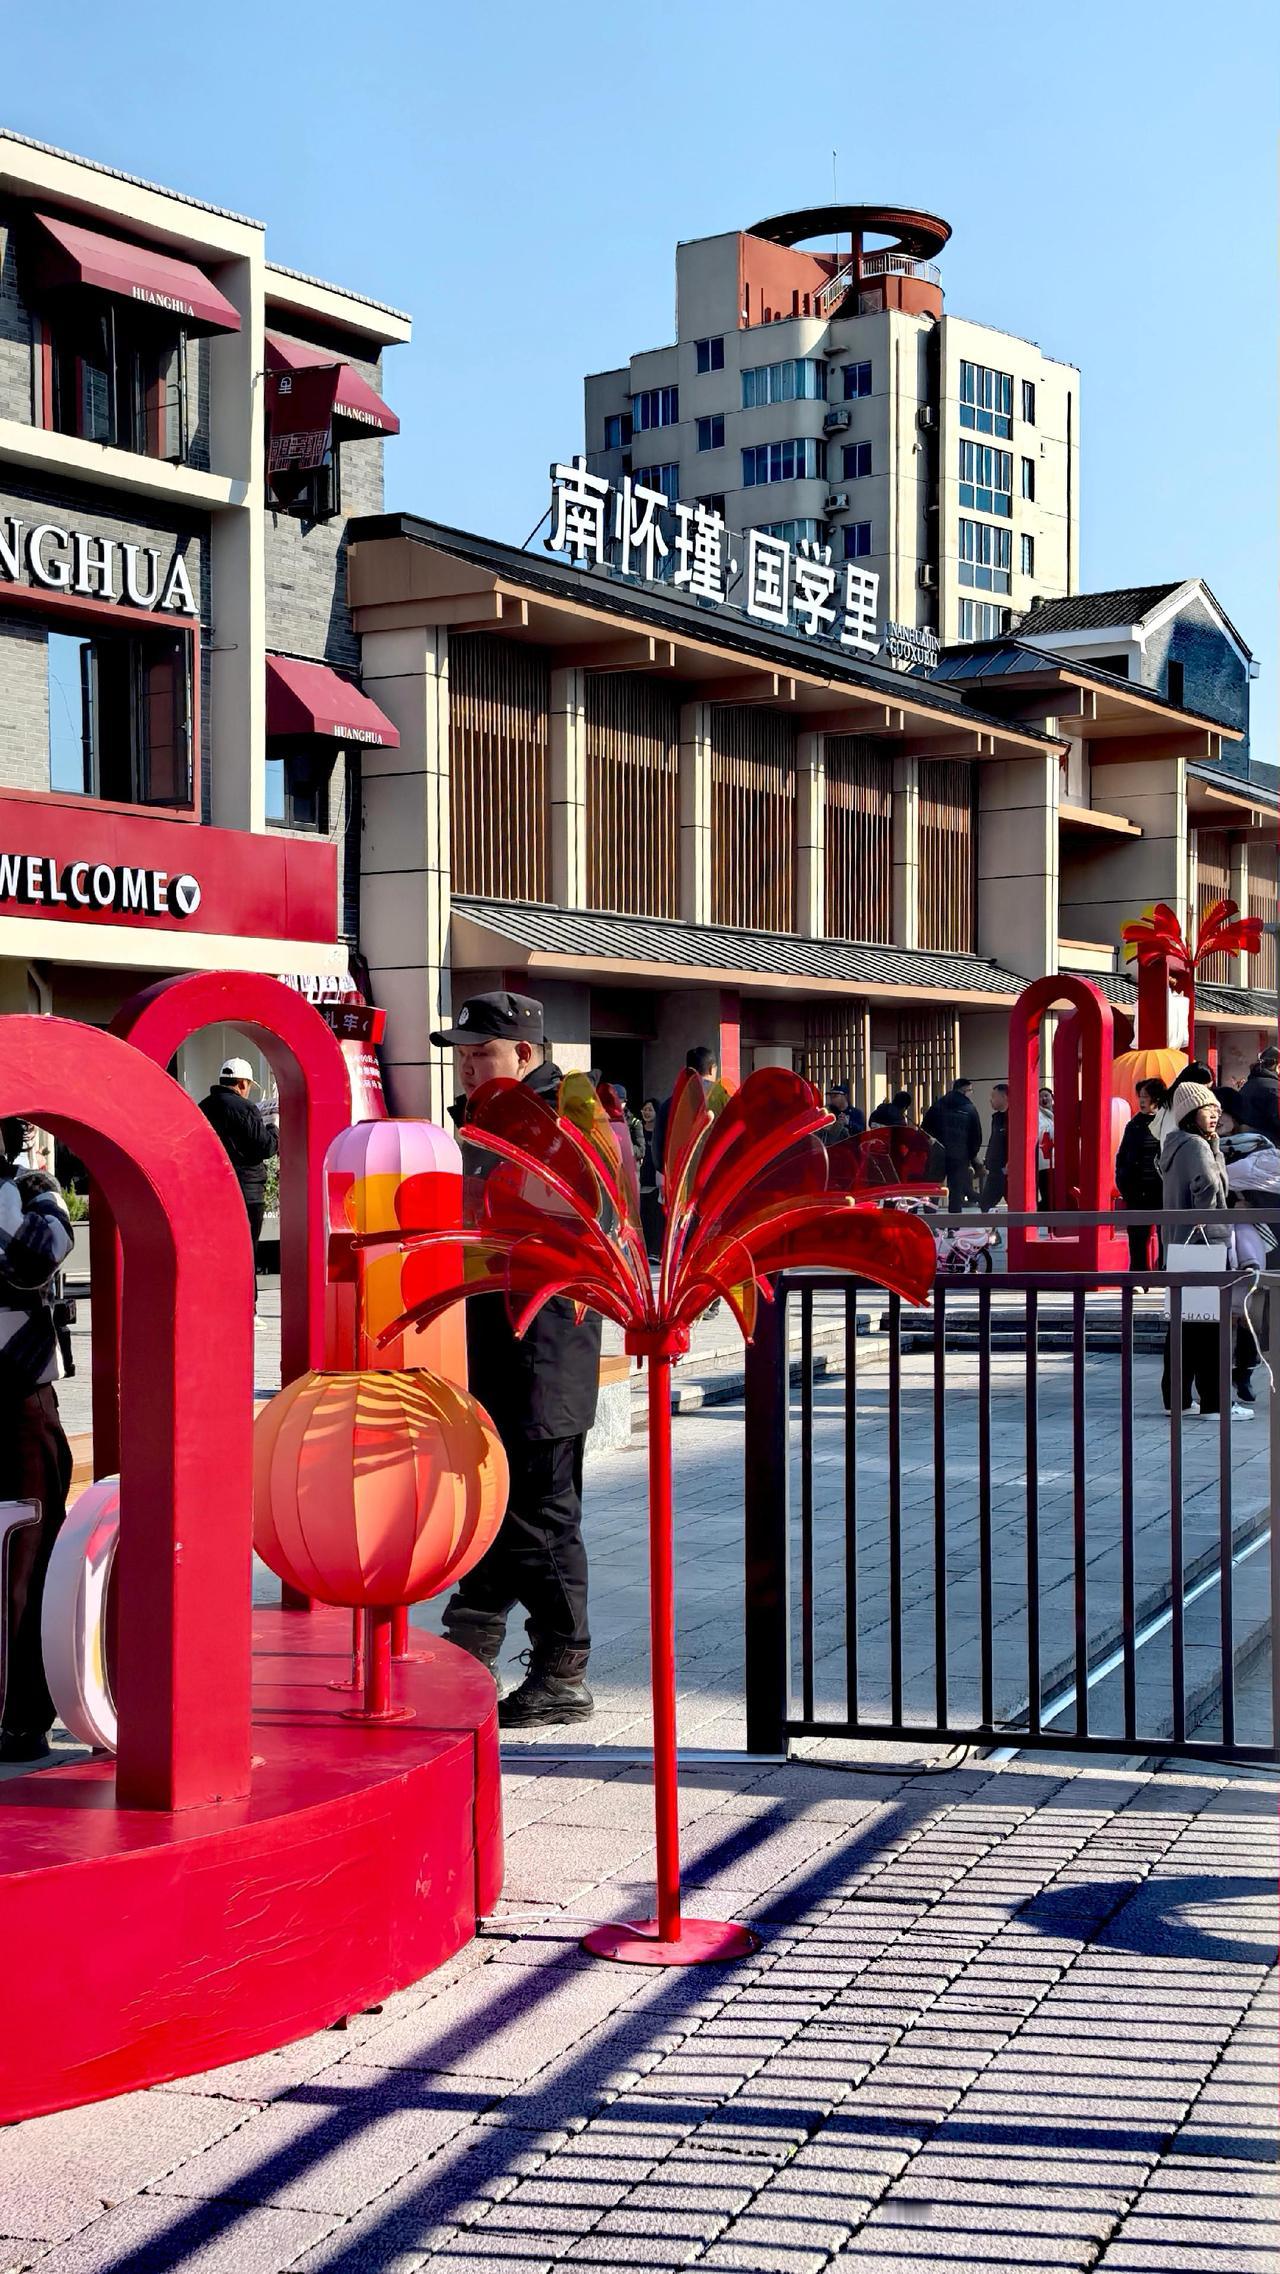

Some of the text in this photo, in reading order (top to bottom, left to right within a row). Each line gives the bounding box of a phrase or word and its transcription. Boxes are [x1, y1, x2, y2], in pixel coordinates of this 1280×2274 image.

[132, 286, 195, 317] HUANGHUA
[334, 402, 383, 428] HUANGHUA
[891, 622, 941, 652] NANHUAIJIN
[334, 724, 383, 745] HUANGHUA
[0, 854, 169, 912] WELCOME
